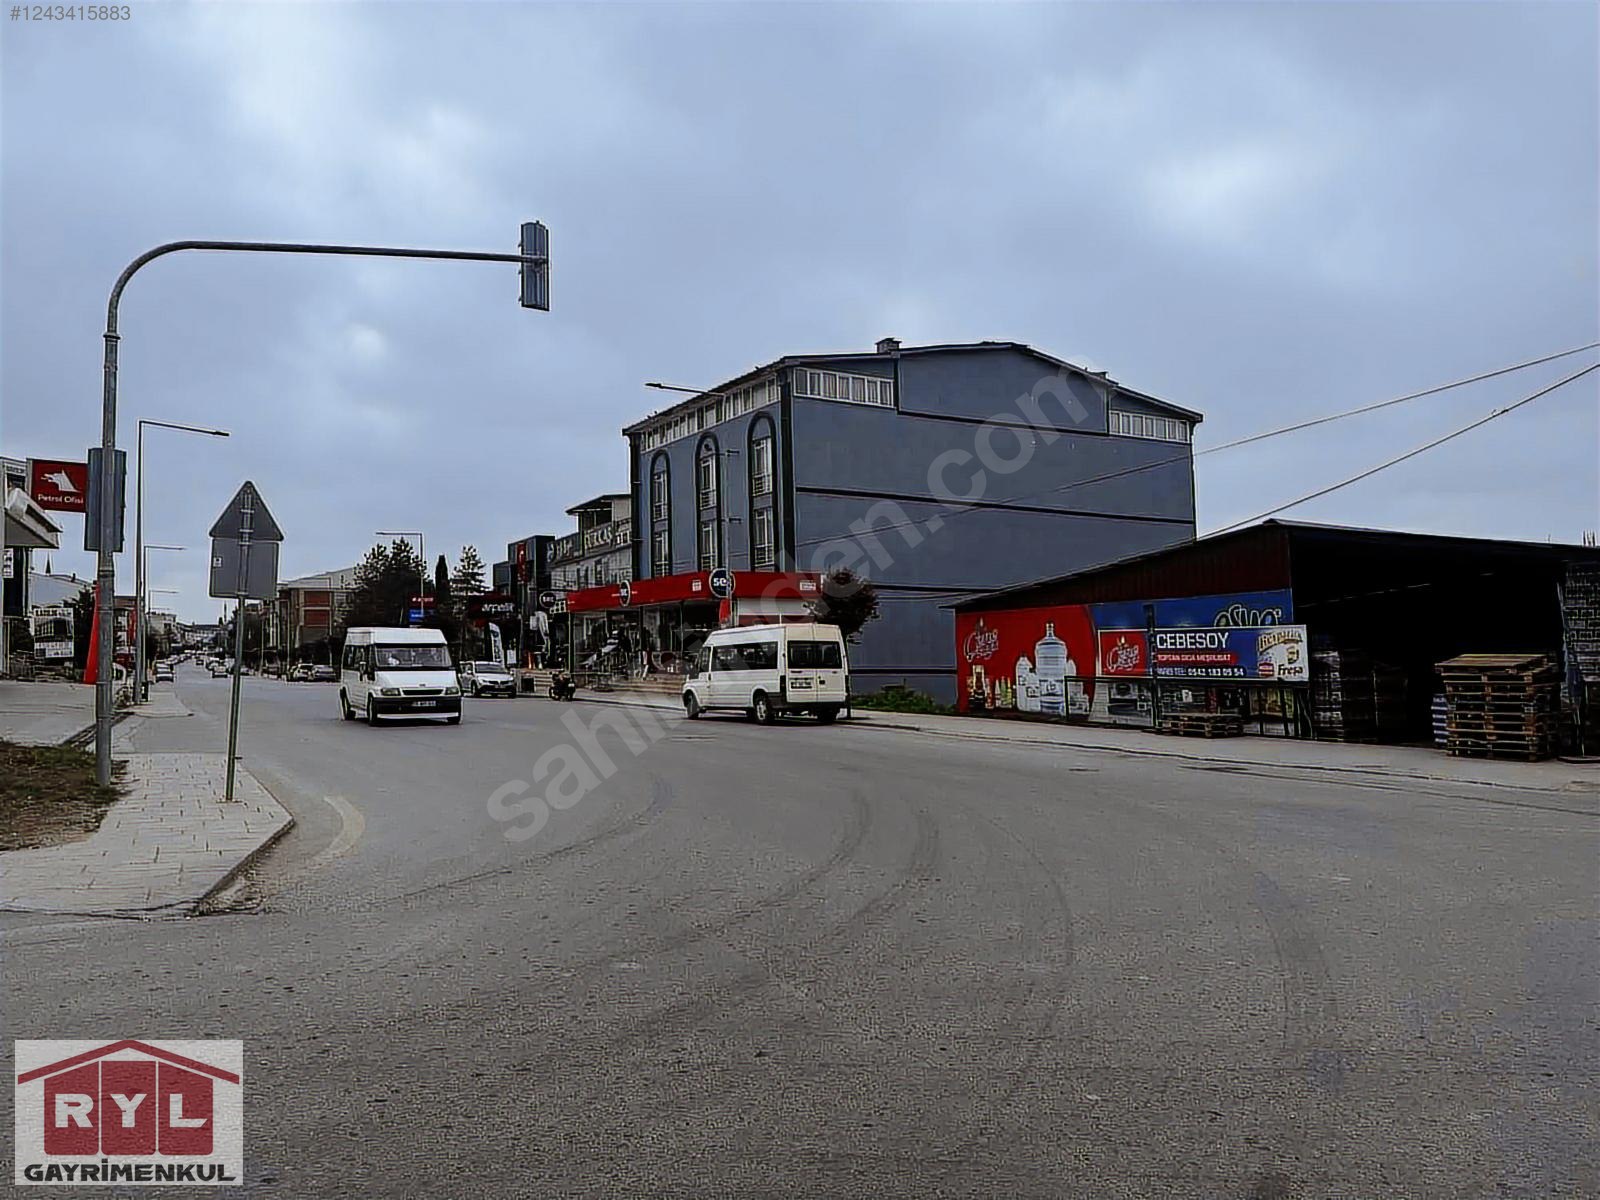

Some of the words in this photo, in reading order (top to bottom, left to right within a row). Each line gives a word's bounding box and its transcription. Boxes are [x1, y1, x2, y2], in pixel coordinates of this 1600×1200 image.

[37, 493, 63, 503] Petrol
[64, 496, 84, 504] Ofisi
[1156, 632, 1229, 649] CEBESOY
